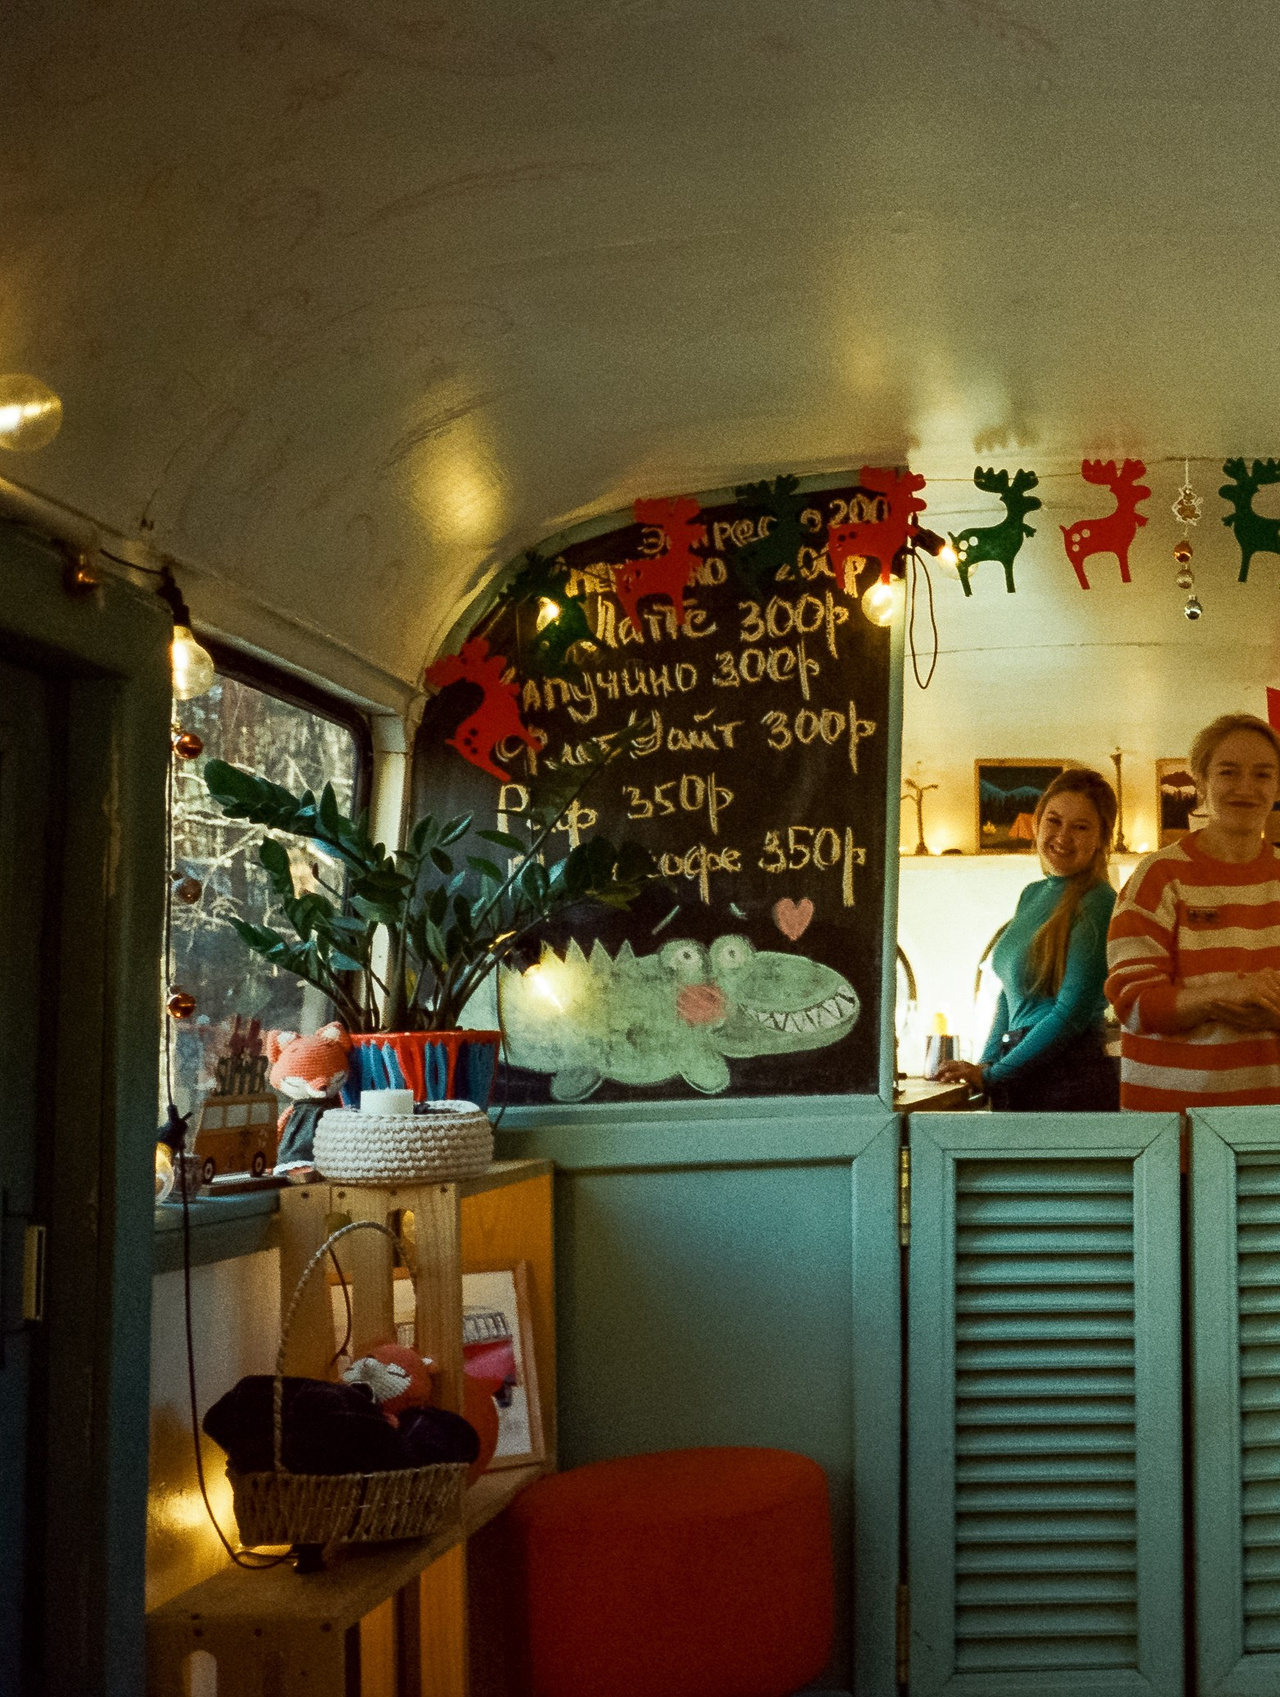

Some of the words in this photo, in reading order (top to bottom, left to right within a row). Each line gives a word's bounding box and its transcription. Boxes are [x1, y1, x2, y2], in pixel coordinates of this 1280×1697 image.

[740, 590, 848, 659] 300р
[500, 663, 697, 723] апучино
[713, 635, 820, 700] 300р
[762, 701, 877, 774] 300р
[623, 771, 735, 835] 350р
[647, 842, 742, 905] офе
[758, 826, 866, 907] 350р
